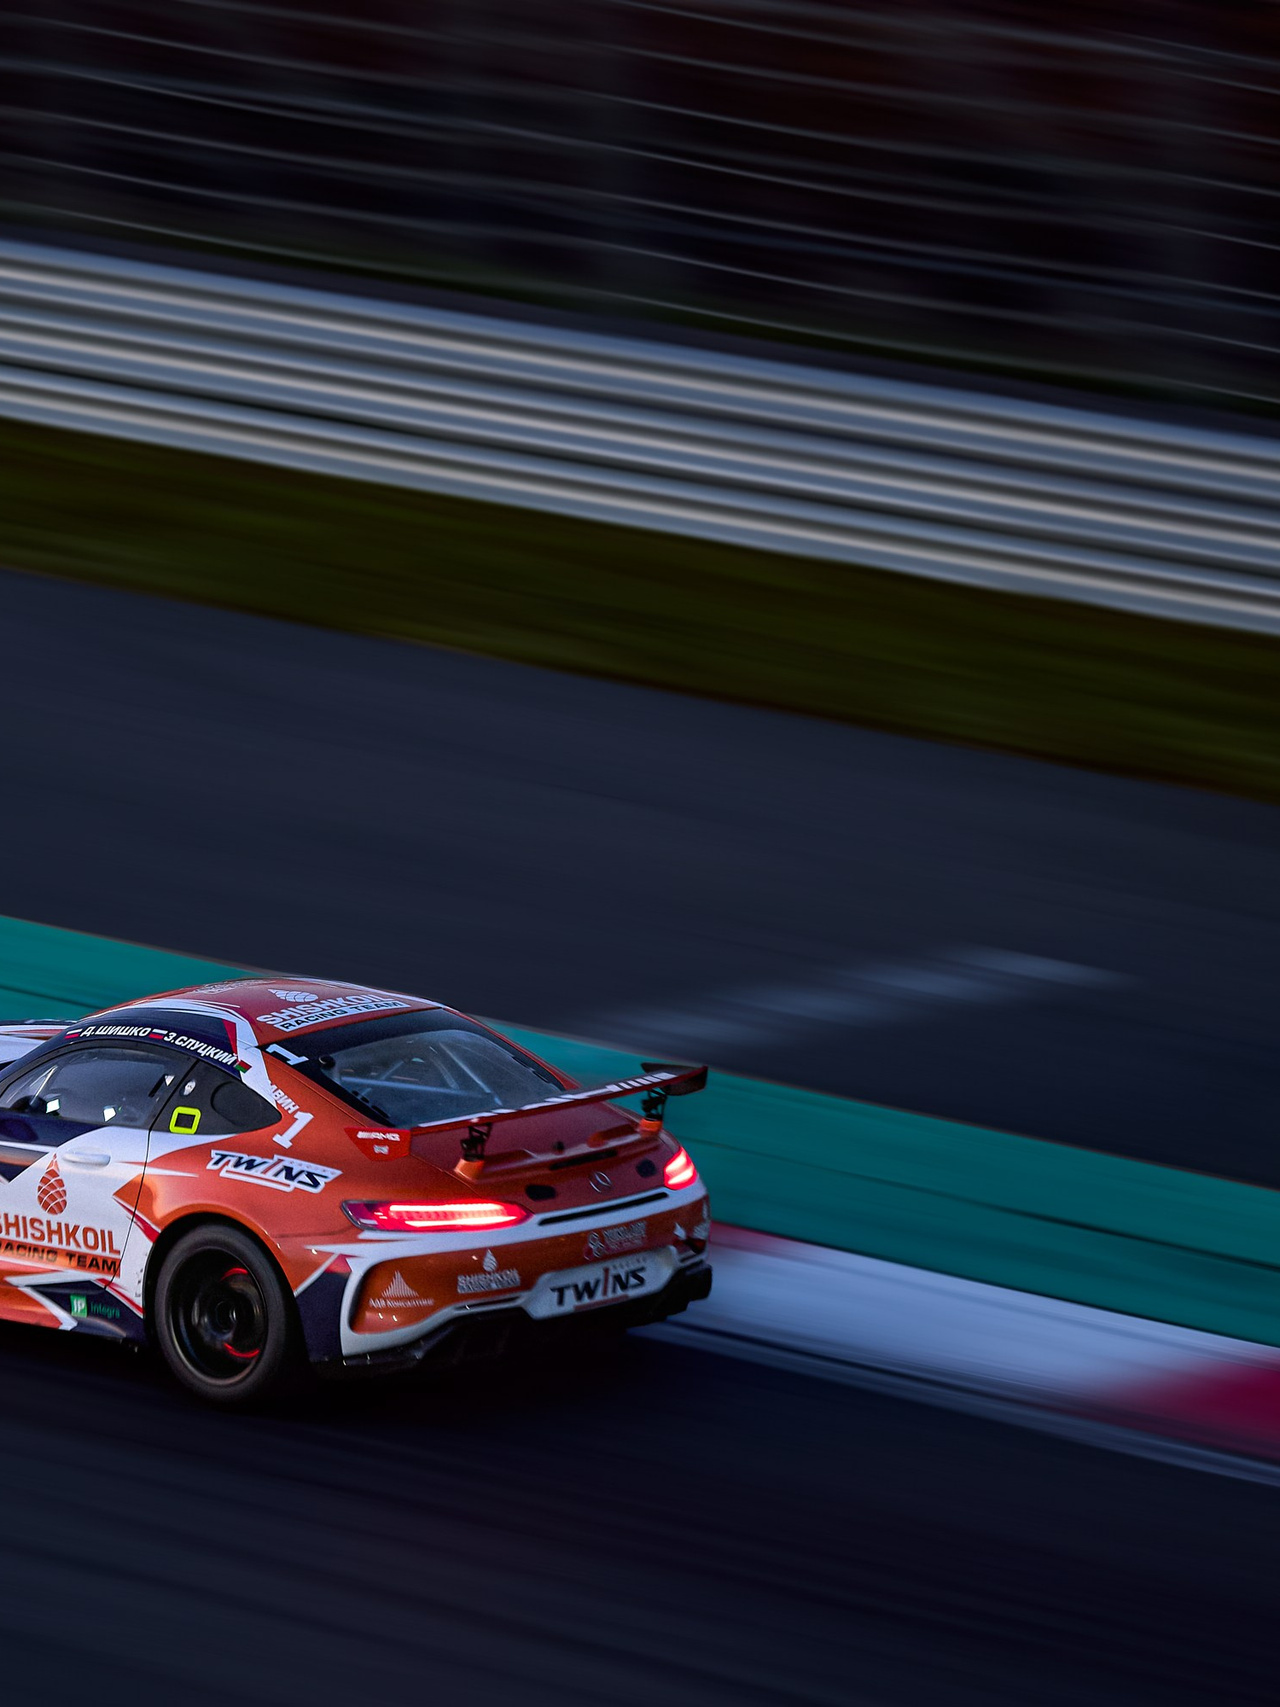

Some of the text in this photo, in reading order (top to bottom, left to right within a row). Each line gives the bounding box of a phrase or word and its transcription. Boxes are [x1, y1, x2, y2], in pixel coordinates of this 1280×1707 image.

[256, 994, 393, 1025] SHISHKOIL
[281, 1001, 404, 1030] RACING TEAM
[80, 1025, 151, 1038] Д.ШИШКО
[164, 1032, 238, 1066] З.СЛУЦКИЙ
[272, 1111, 315, 1149] 1
[213, 1152, 328, 1188] TWINS
[65, 1252, 118, 1273] TEAM
[550, 1266, 646, 1306] TWINS
